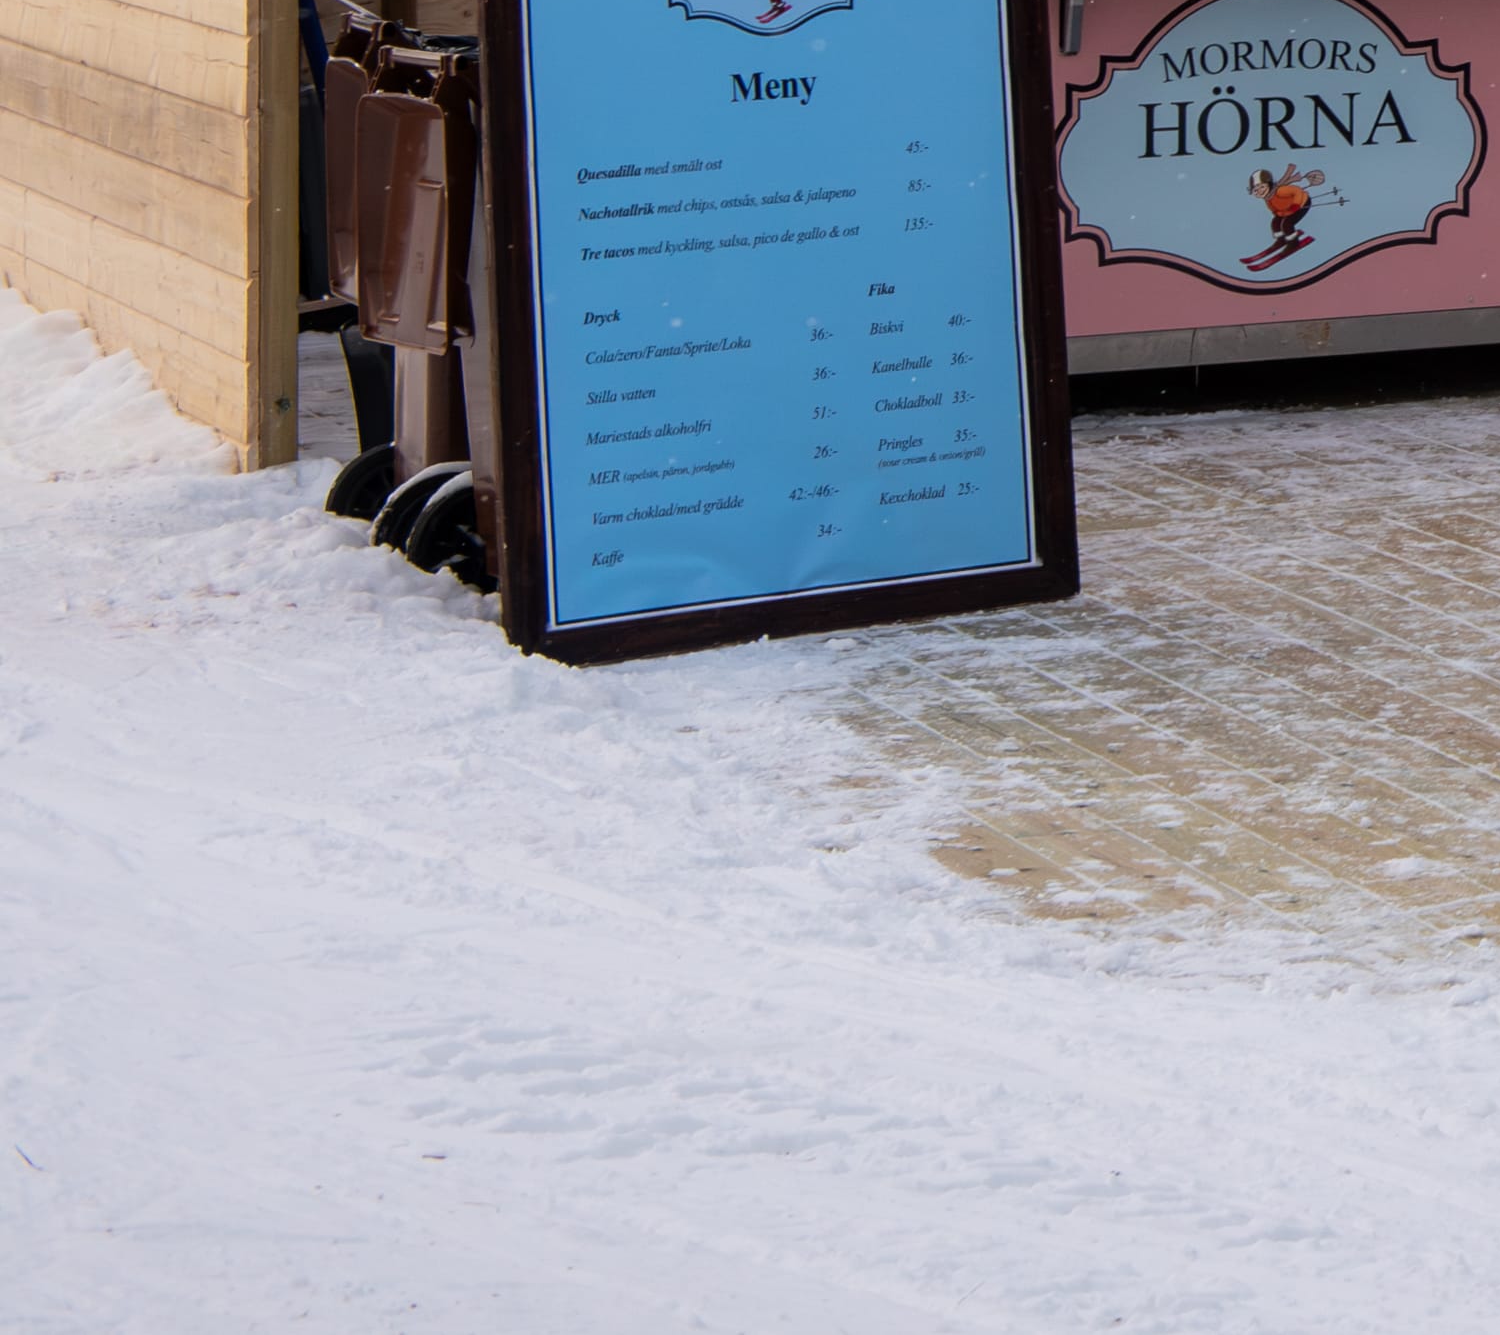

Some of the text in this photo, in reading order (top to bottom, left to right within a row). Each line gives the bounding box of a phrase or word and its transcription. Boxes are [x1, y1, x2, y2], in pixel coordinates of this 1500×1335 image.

[1160, 38, 1379, 84] MORMORS
[729, 71, 817, 106] Meny
[1138, 86, 1418, 160] HÖRNA
[577, 164, 641, 184] Quesadilla
[644, 162, 670, 175] med
[705, 159, 723, 171] ost
[578, 203, 654, 221] Nachotallrik
[657, 200, 683, 213] med
[761, 191, 790, 205] salsa
[580, 248, 602, 261] Tre
[604, 246, 635, 259] tacos
[637, 242, 662, 256] med
[752, 232, 778, 249] pico
[780, 230, 795, 244] de
[797, 227, 827, 245] gallo
[843, 225, 860, 237] ost
[868, 283, 895, 297] Fika
[583, 308, 621, 327] Dryck
[869, 320, 904, 336] Biskvi
[872, 355, 933, 375] Kanelbulle
[586, 388, 656, 405] Stilla vatten
[874, 393, 943, 413] Chokladboll
[585, 419, 712, 446] Mariestads alkoholfri
[878, 434, 923, 452] Pringles
[588, 469, 620, 485] MER
[879, 484, 946, 505] Kexchoklad
[592, 511, 623, 526] Varm
[703, 495, 745, 515] grädde
[591, 550, 625, 567] Kaffe
